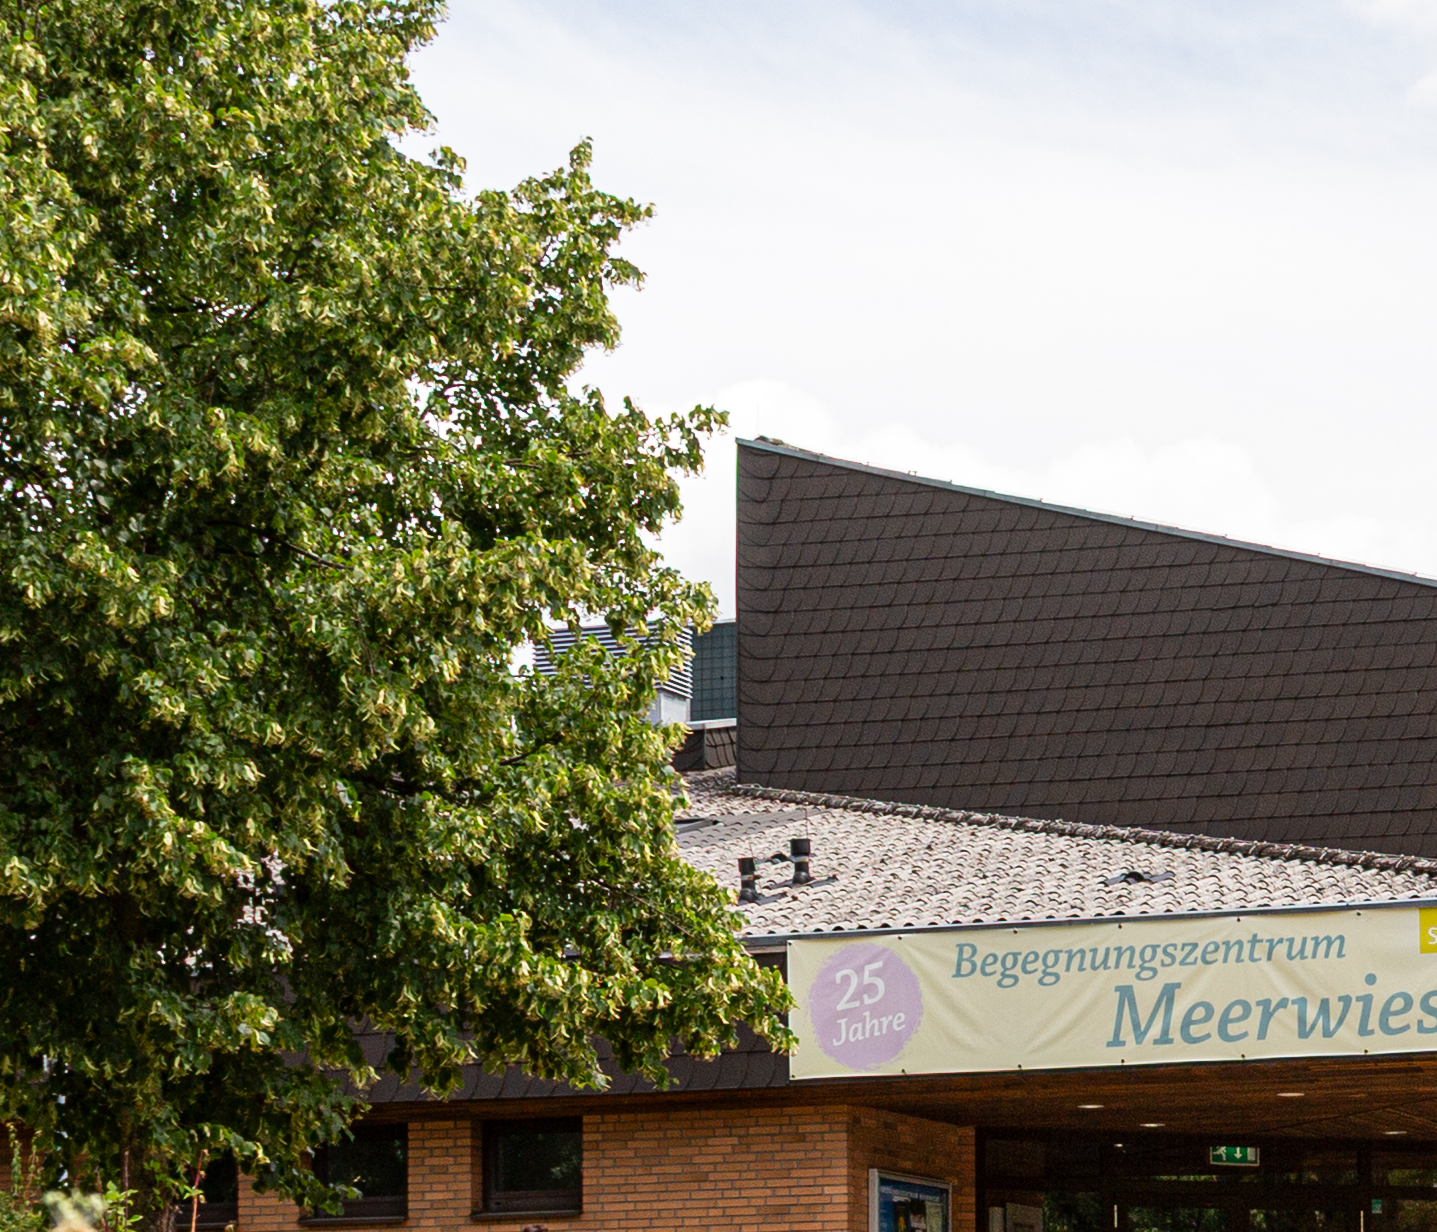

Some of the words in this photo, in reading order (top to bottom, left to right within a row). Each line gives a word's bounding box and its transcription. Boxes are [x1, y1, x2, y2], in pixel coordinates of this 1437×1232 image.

[834, 960, 886, 1012] 25
[951, 932, 1347, 989] Begegnungszentrum
[832, 1008, 907, 1048] Jahre
